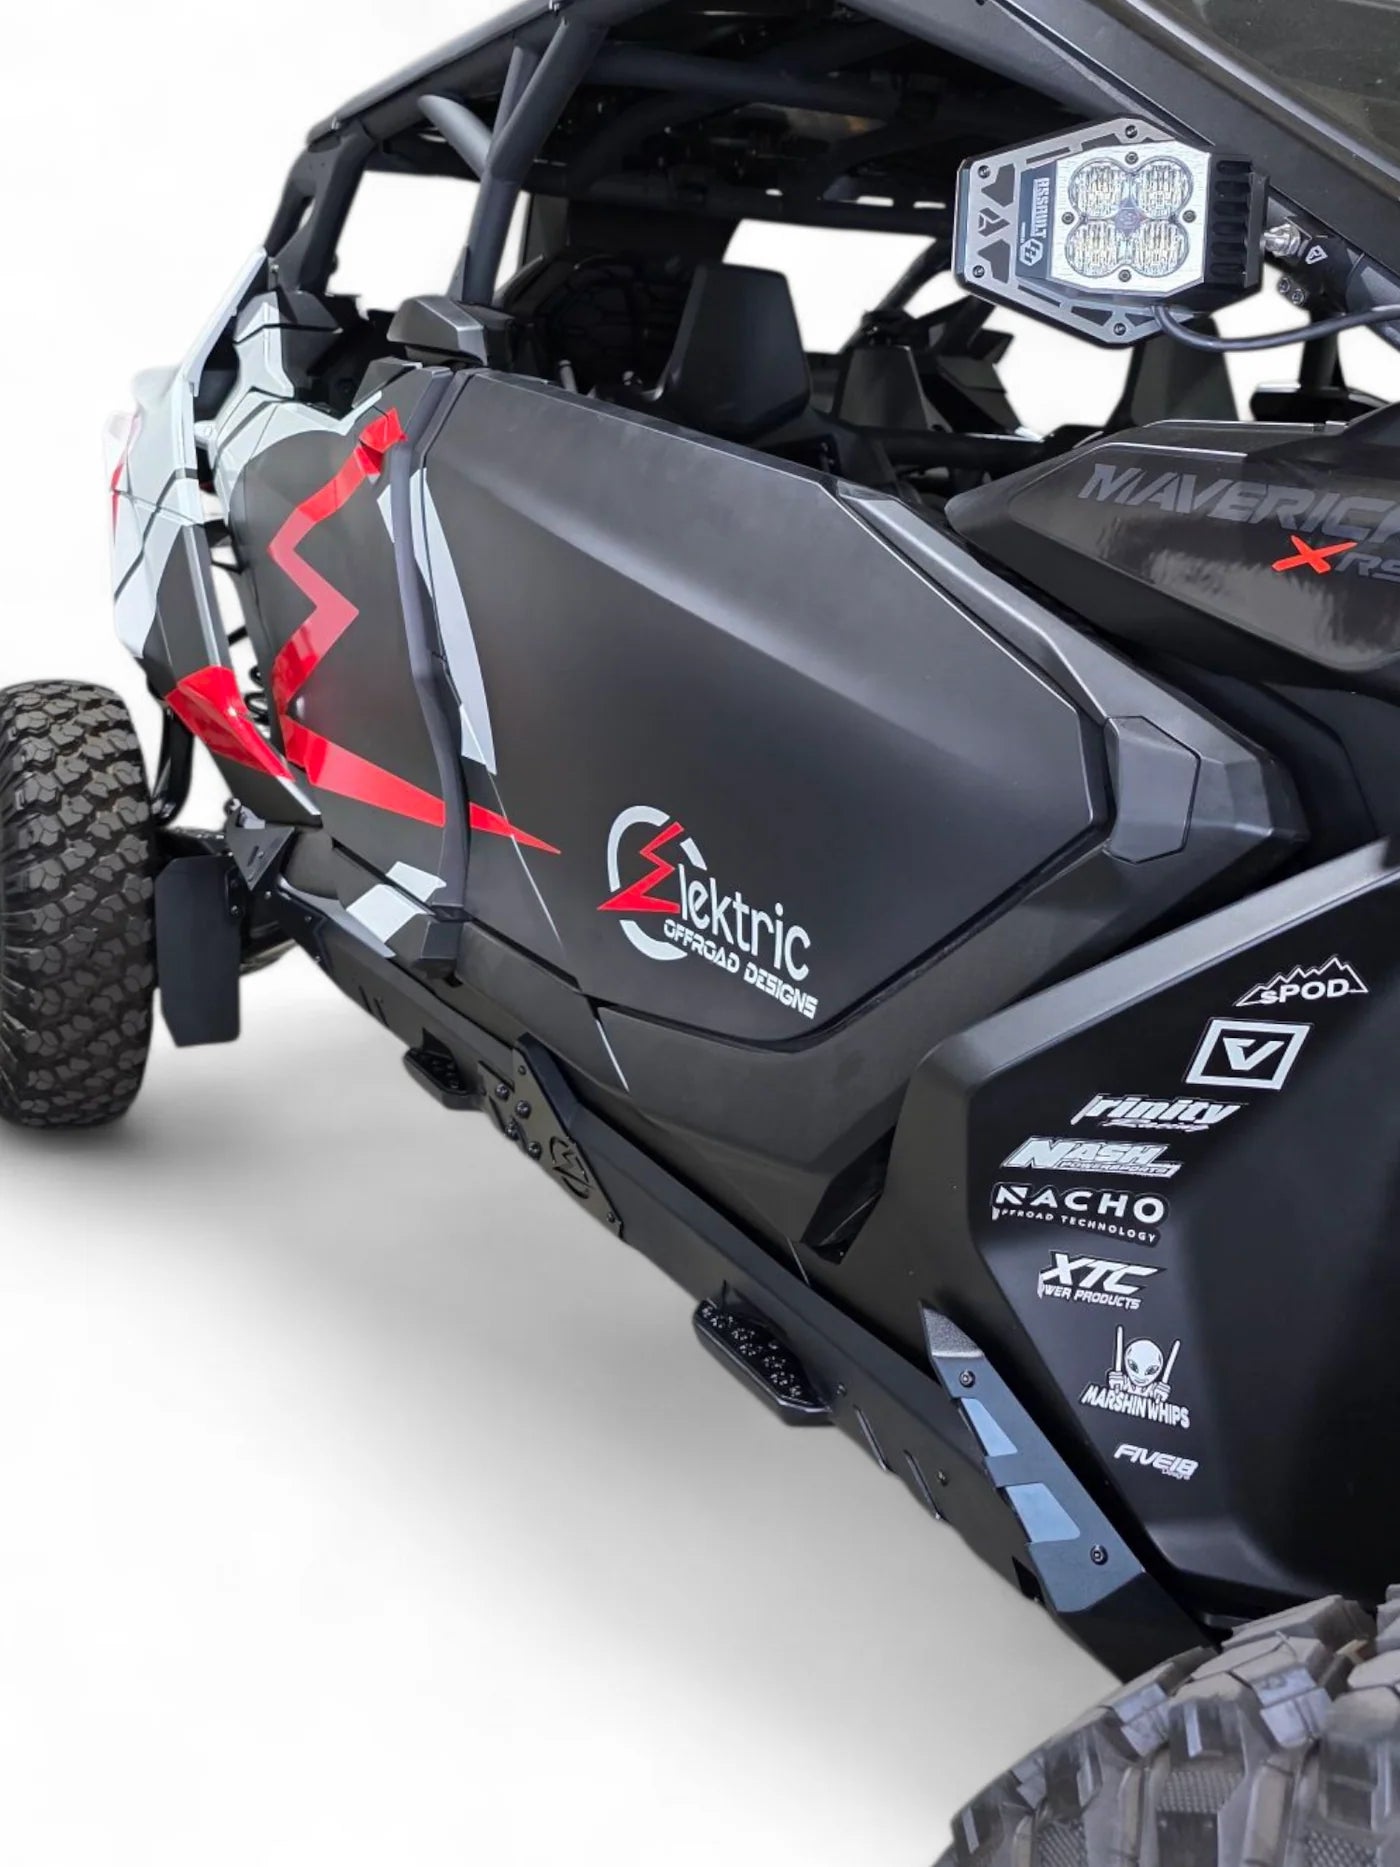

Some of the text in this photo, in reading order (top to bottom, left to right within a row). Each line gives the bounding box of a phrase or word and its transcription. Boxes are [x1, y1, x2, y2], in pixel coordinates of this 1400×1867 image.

[663, 919, 818, 1020] OFFROAD DESIGNS
[995, 1185, 1165, 1224] NACHO
[1060, 1214, 1157, 1243] TECHNOLOGY
[1040, 1253, 1159, 1295] XTC
[1037, 1284, 1142, 1311] WER PRODUCTS
[1081, 1384, 1191, 1429] MARSHIN WHIPS
